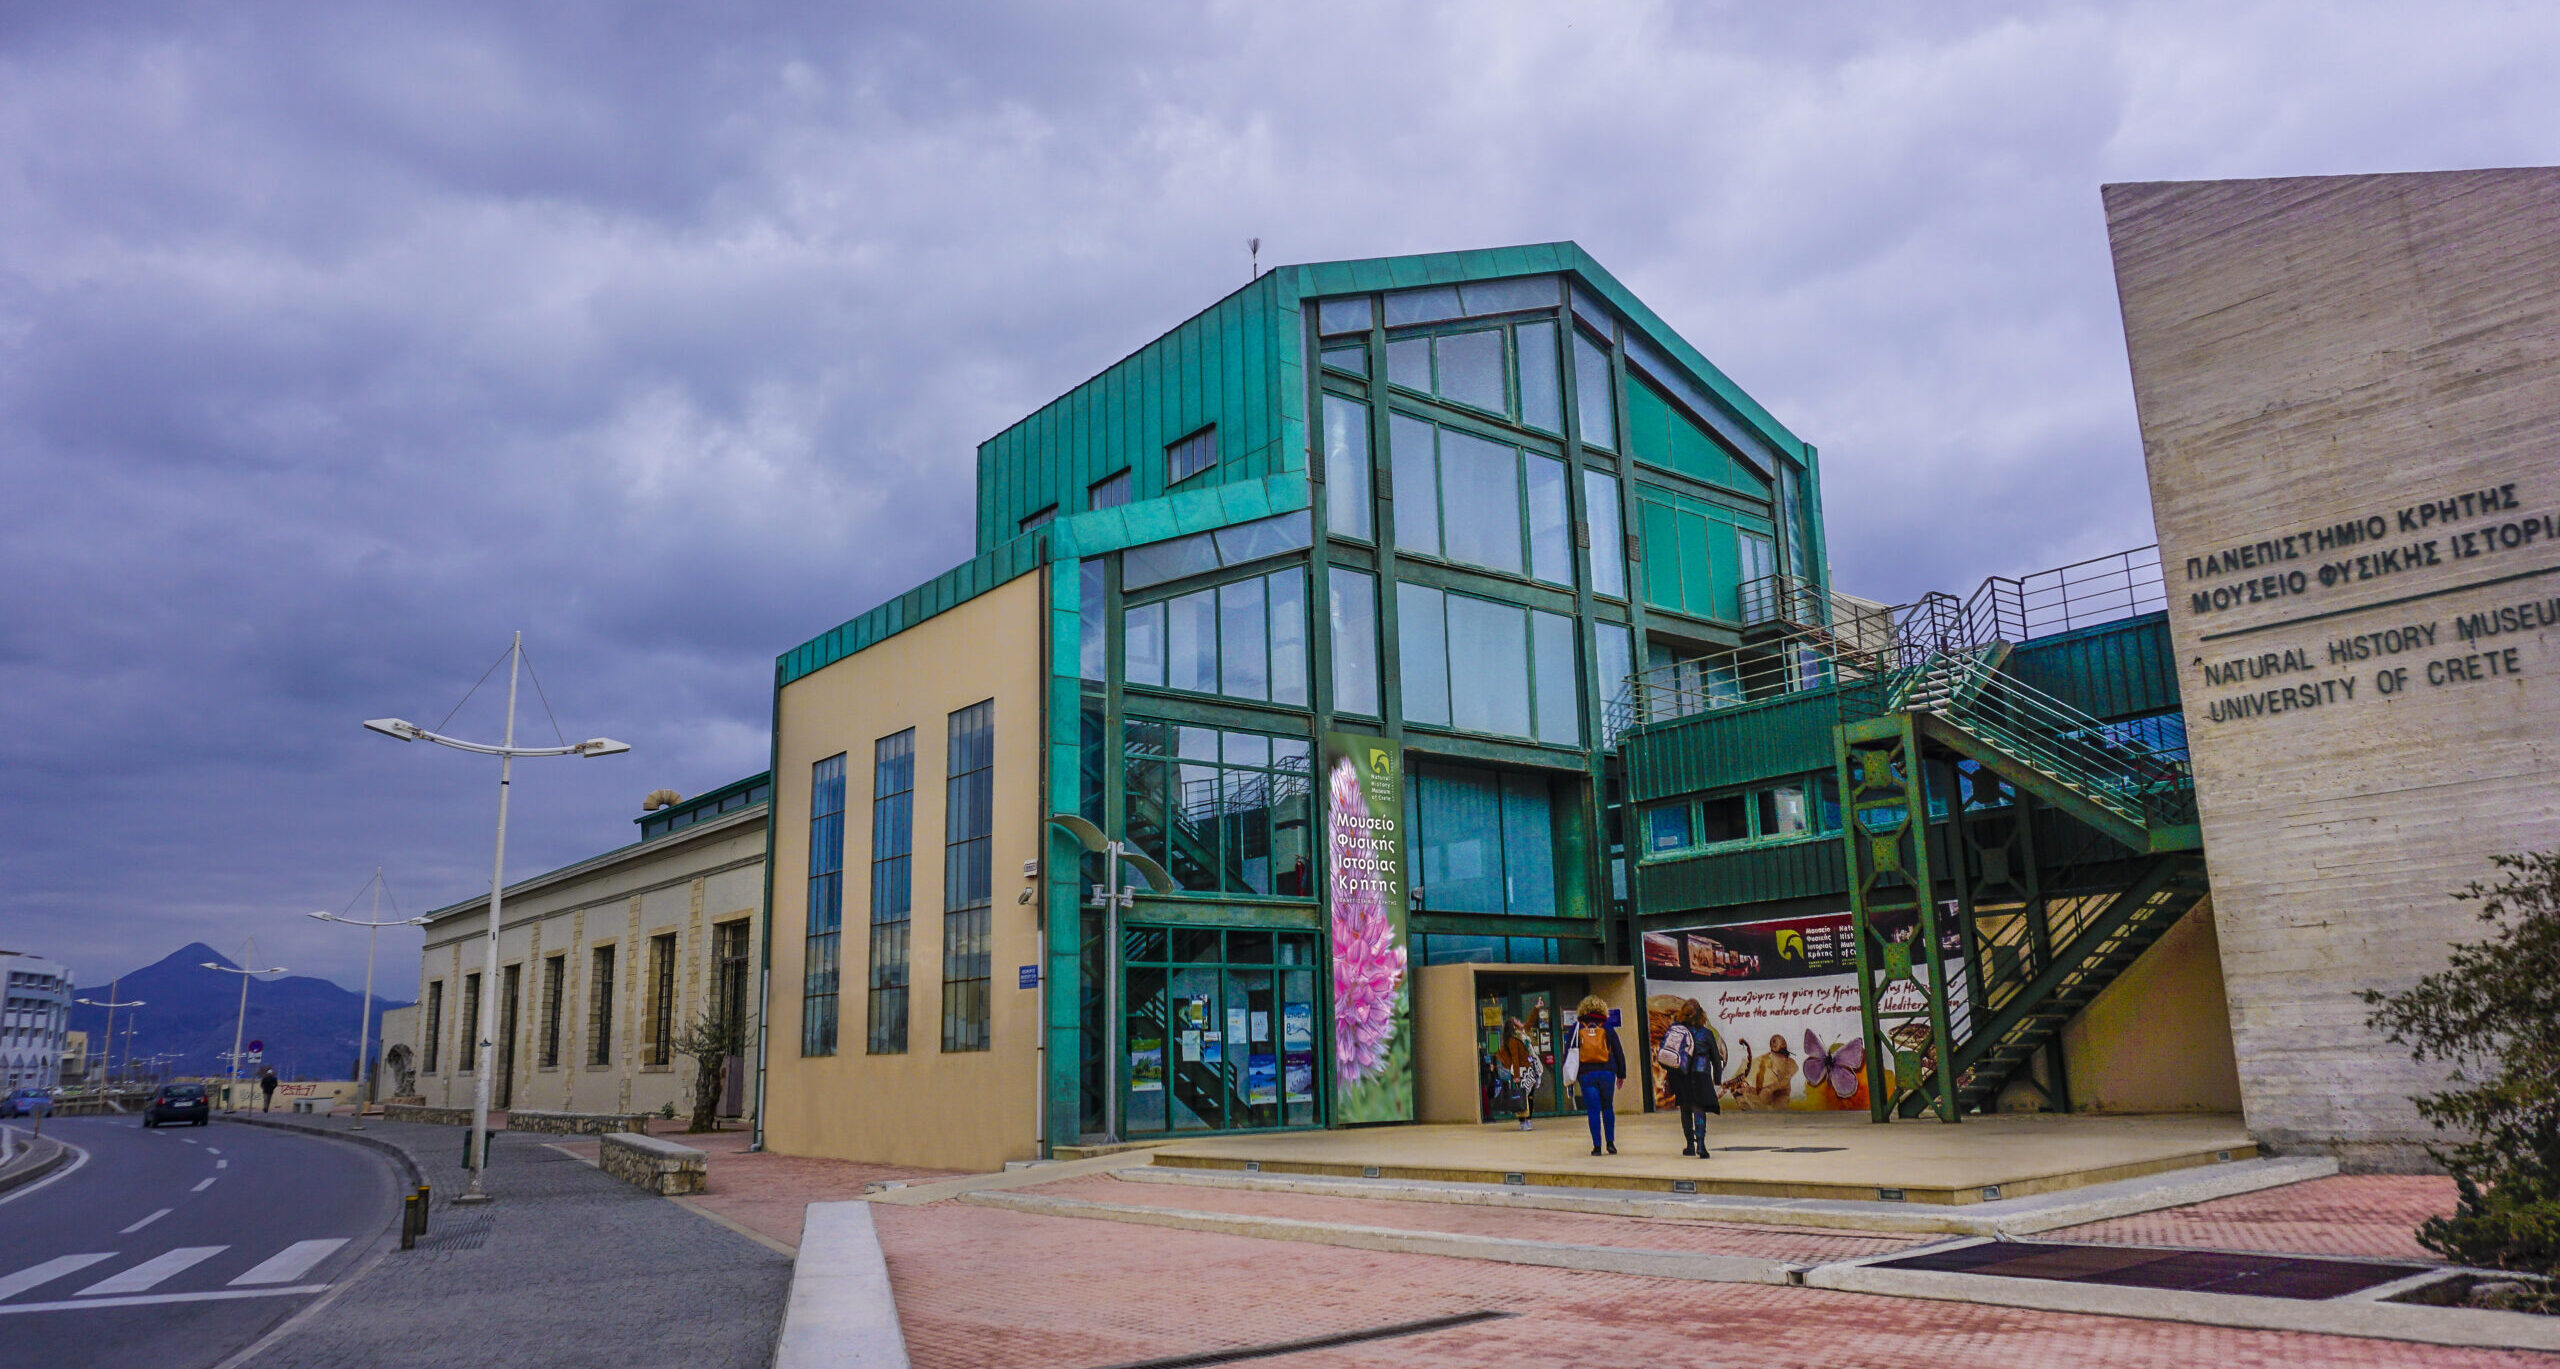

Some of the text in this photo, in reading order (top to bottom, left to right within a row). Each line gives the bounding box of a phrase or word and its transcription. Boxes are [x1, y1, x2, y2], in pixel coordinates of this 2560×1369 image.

[2187, 484, 2520, 580] ΠΑΝΕΠΙΣΤΗΜΙΟ ΚΡΗΤΗΣ
[2192, 514, 2560, 614] ΜΟΥΣΕΙΟ ΦΥΣΙΚΗΣ ΙΣΤΟΡΙ
[2205, 598, 2560, 686] NATURAL HISTORY MUSEU
[2210, 647, 2521, 723] UNIVERSITY OF CRETE
[1337, 813, 1395, 831] Μουσείο
[1337, 834, 1395, 853] Φυσικής
[1338, 854, 1396, 874] Ιστορίας
[1339, 874, 1397, 895] Κρήτης
[1808, 950, 1833, 959] Κρήτης
[1718, 1007, 1751, 1024] Explore
[1753, 1006, 1767, 1018] the
[1770, 1005, 1800, 1016] nature
[1802, 1004, 1813, 1017] of
[1813, 1003, 1843, 1015] Crete
